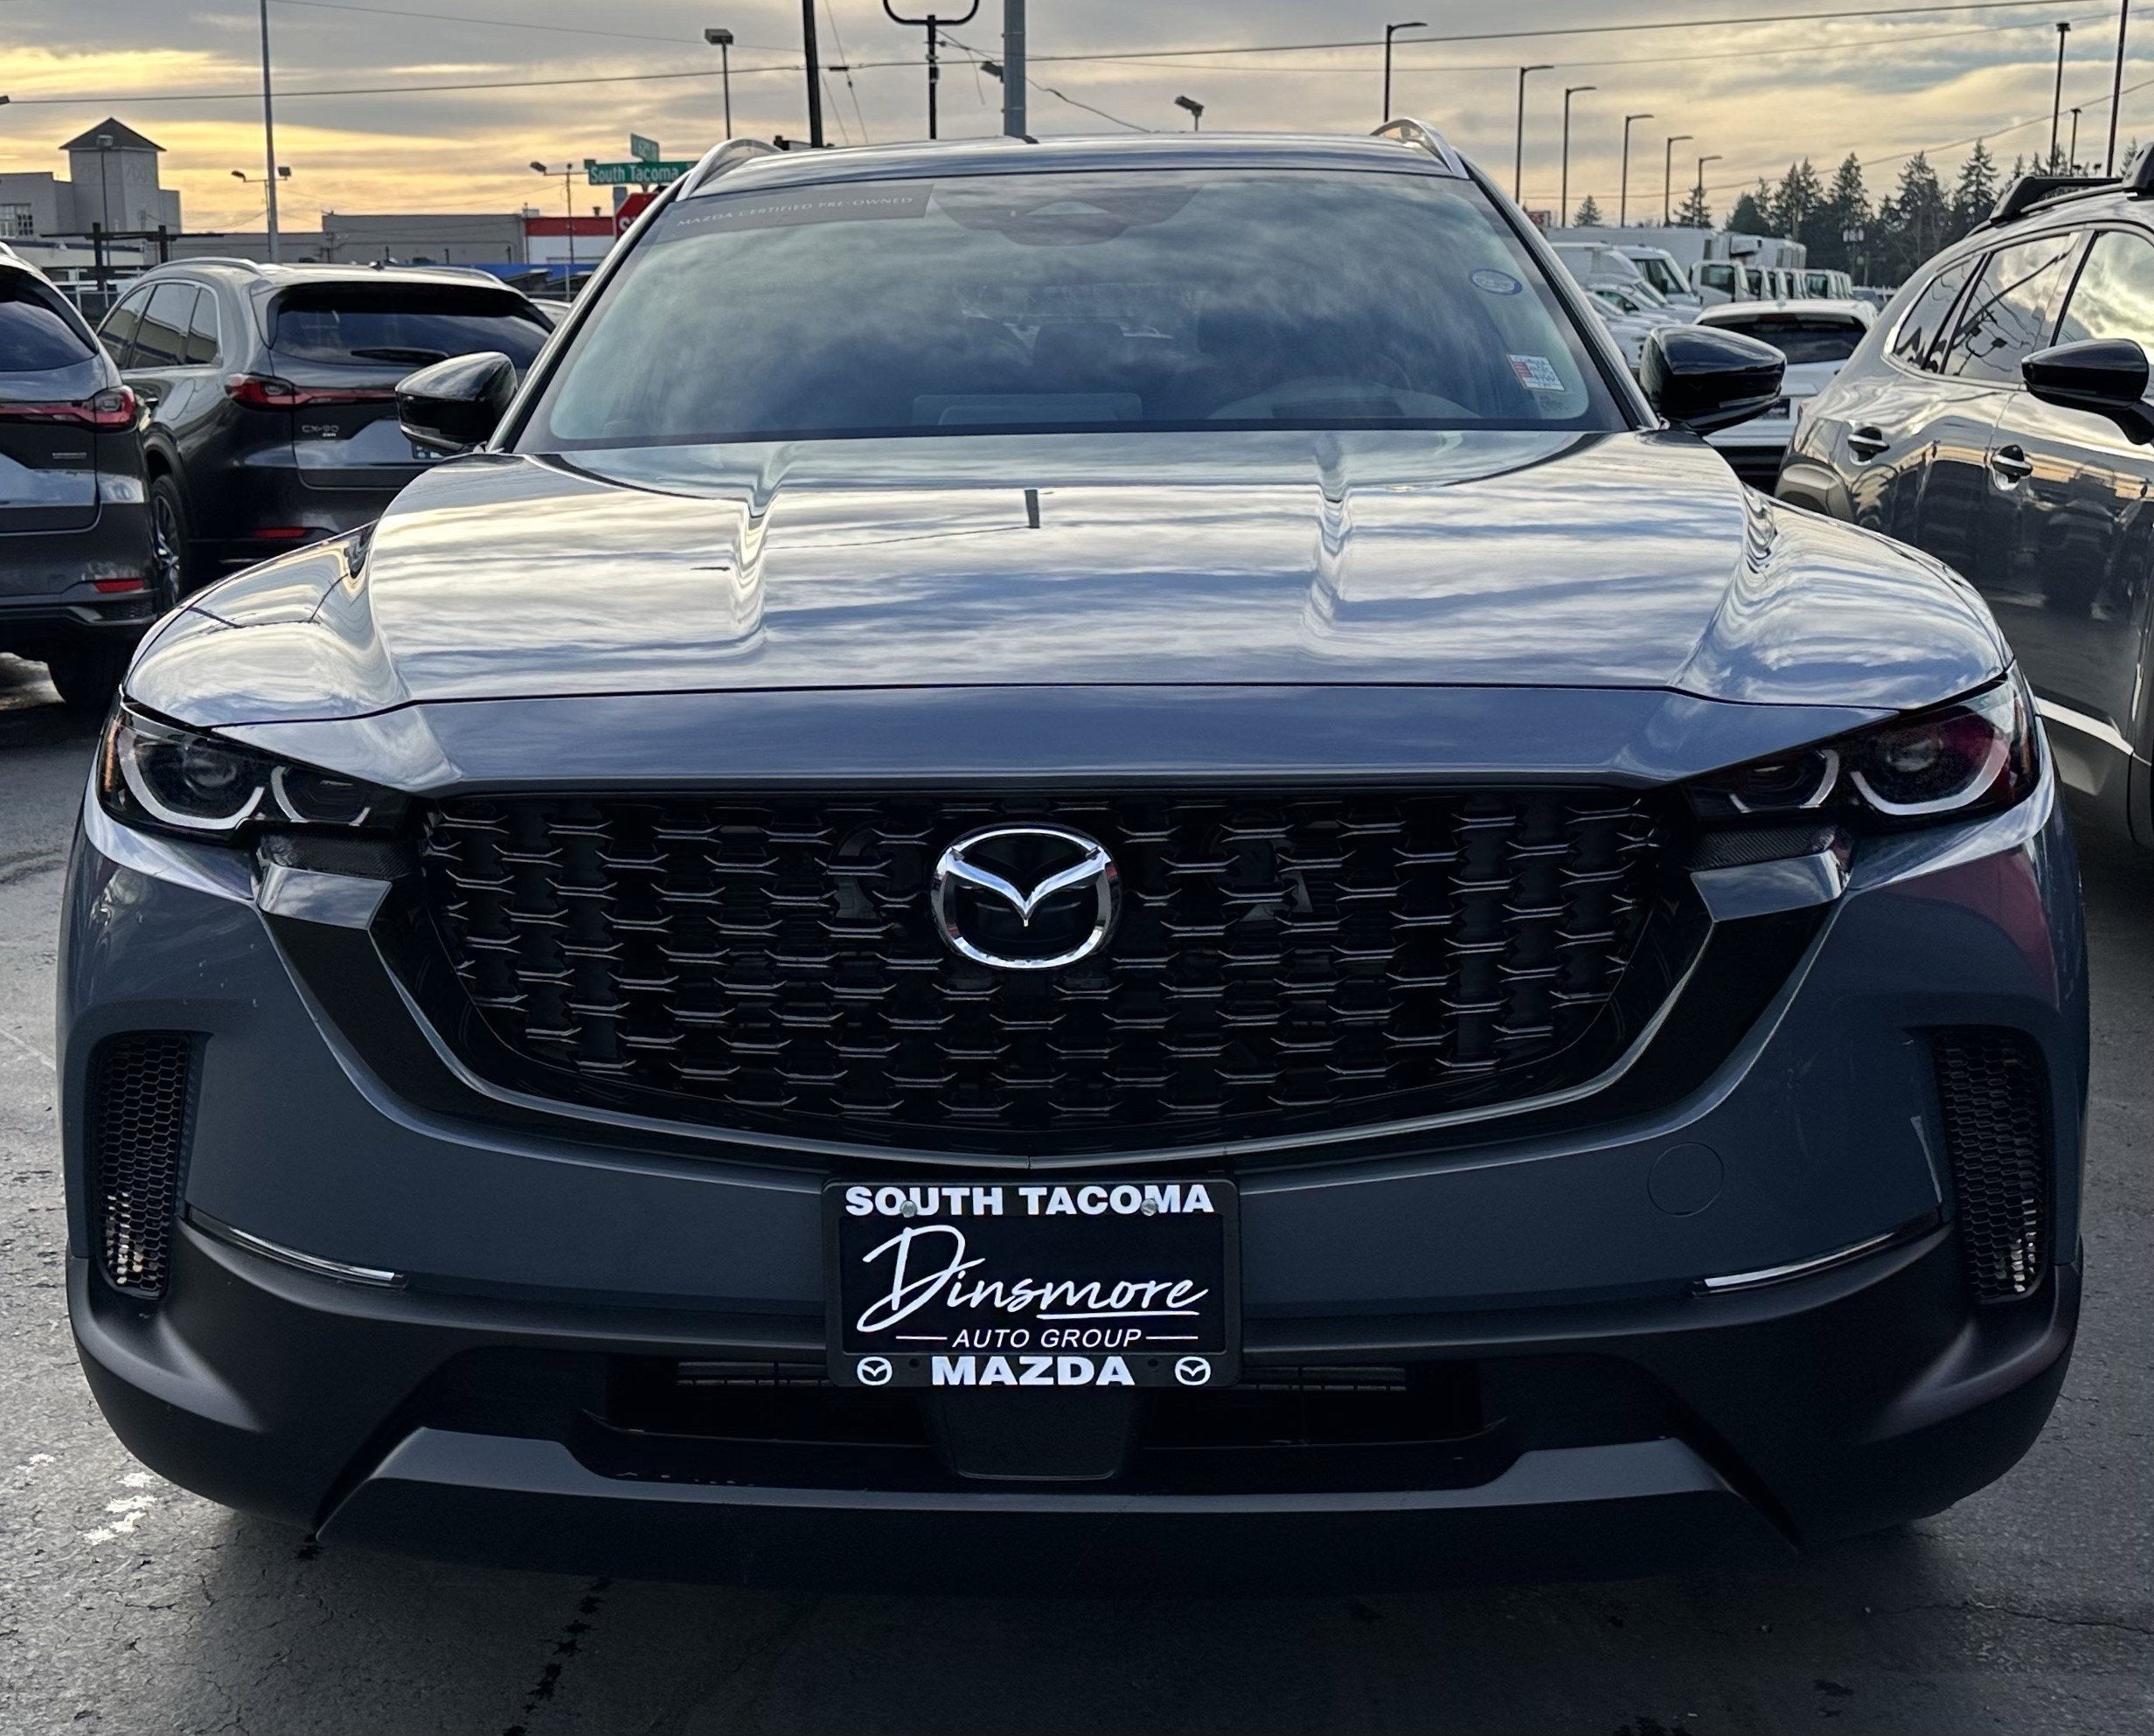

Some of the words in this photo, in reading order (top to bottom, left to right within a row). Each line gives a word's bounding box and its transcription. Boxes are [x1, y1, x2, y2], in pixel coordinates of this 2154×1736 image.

[590, 166, 626, 183] South
[630, 164, 679, 182] Tacoma
[677, 212, 733, 226] MAZDA
[738, 204, 813, 217] CERTIFIED
[818, 198, 913, 208] PRE-OWNED
[845, 1185, 1003, 1216] SOUTH
[1018, 1184, 1214, 1216] TACOMA
[857, 1225, 1209, 1332] Dinsmore
[952, 1329, 1030, 1348] AUTO
[1040, 1328, 1142, 1348] GROUP
[932, 1356, 1136, 1385] MAZDA
